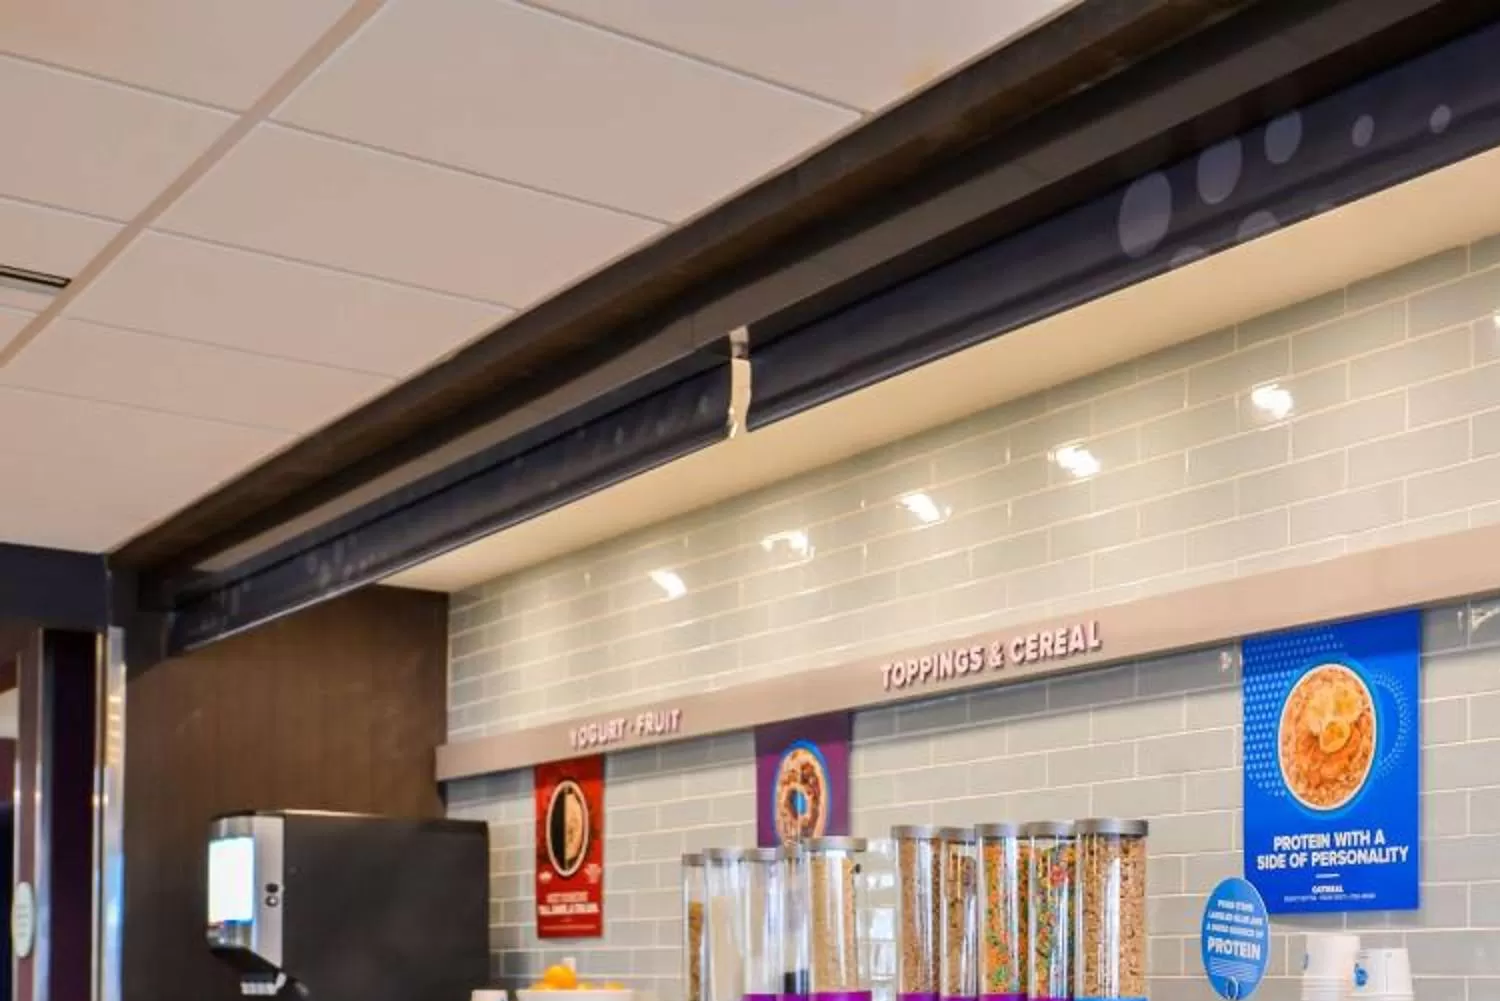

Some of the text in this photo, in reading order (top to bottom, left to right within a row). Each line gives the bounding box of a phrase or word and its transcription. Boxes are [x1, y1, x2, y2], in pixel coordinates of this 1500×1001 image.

[880, 620, 1102, 690] TOPPINGS & CEREAL
[570, 708, 681, 748] YOGURT FRUIT
[1273, 828, 1386, 851] PROTEIN WITH A
[1257, 846, 1409, 870] SIDE OF PERSONALITY
[1207, 935, 1261, 961] PROTEIN
